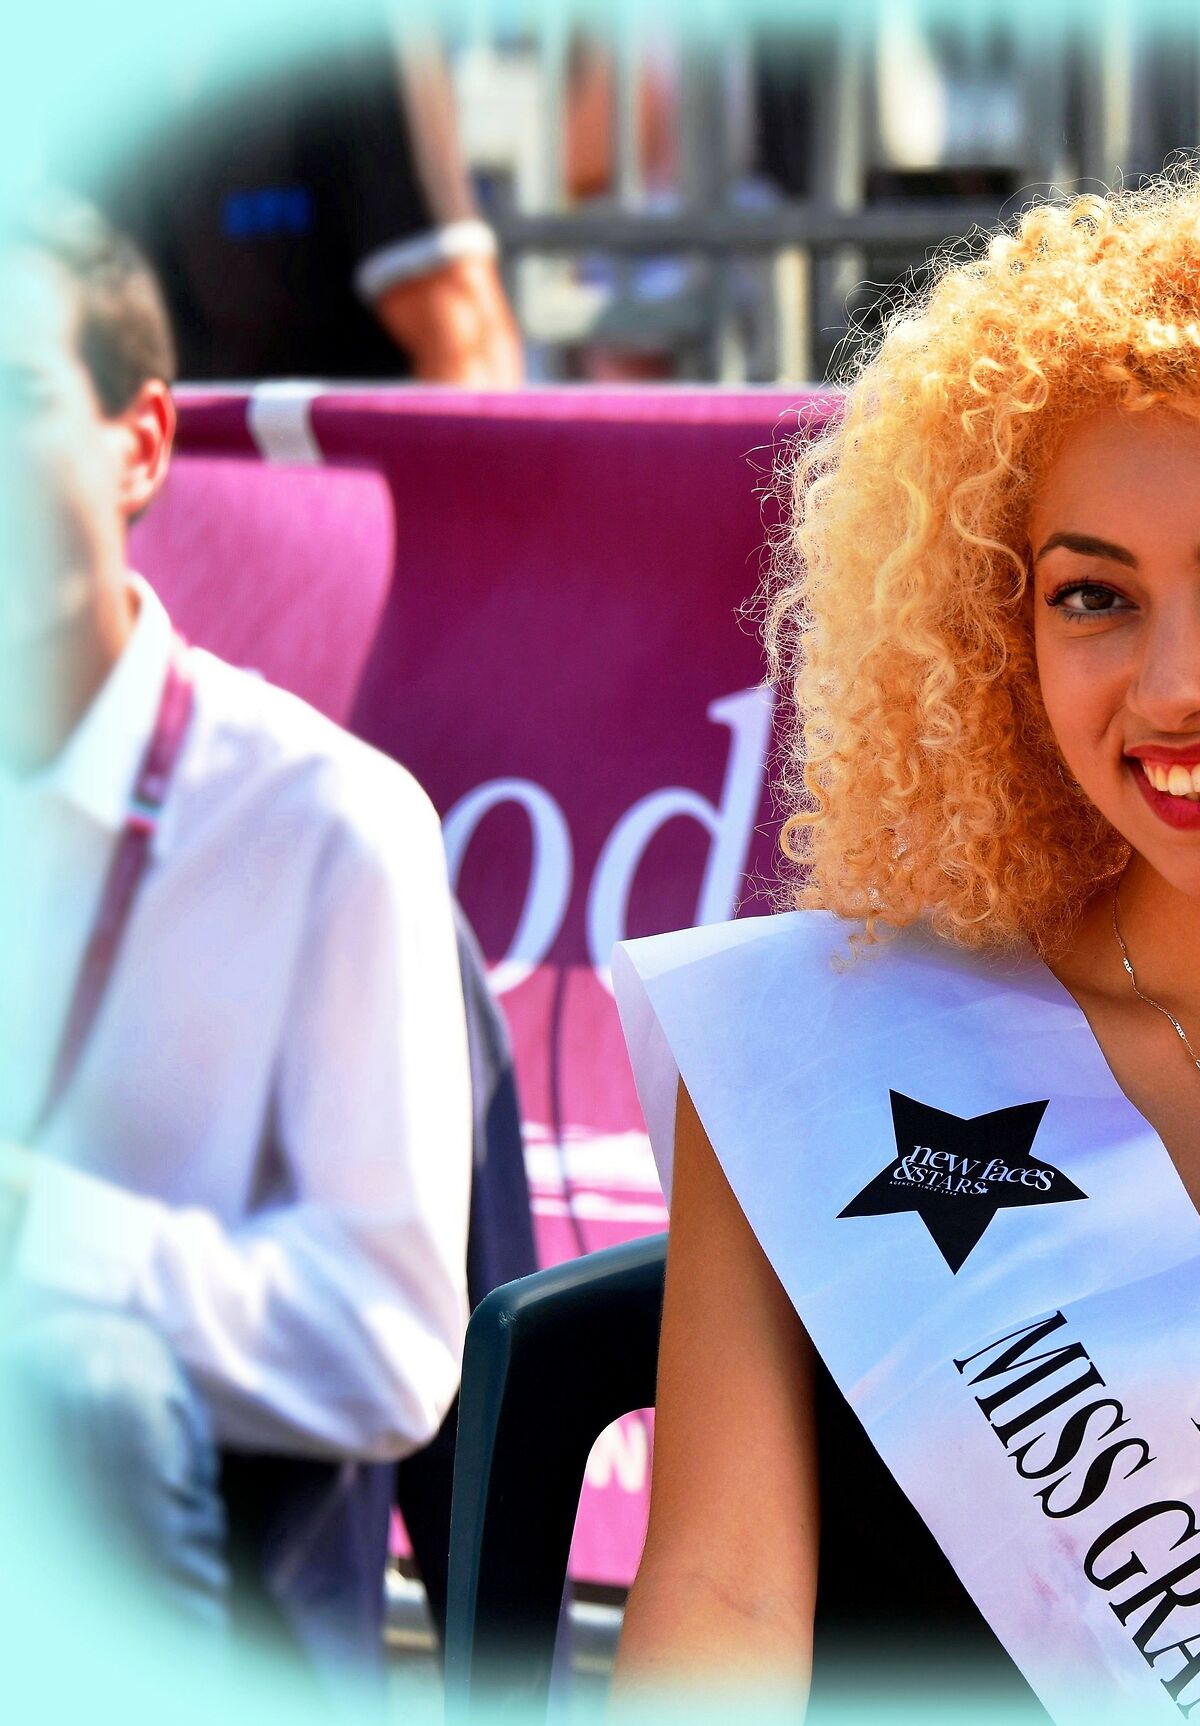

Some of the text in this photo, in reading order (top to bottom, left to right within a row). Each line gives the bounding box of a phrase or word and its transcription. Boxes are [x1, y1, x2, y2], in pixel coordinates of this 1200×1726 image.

[908, 1145, 1055, 1191] new faces
[952, 1310, 1158, 1518] MISS
